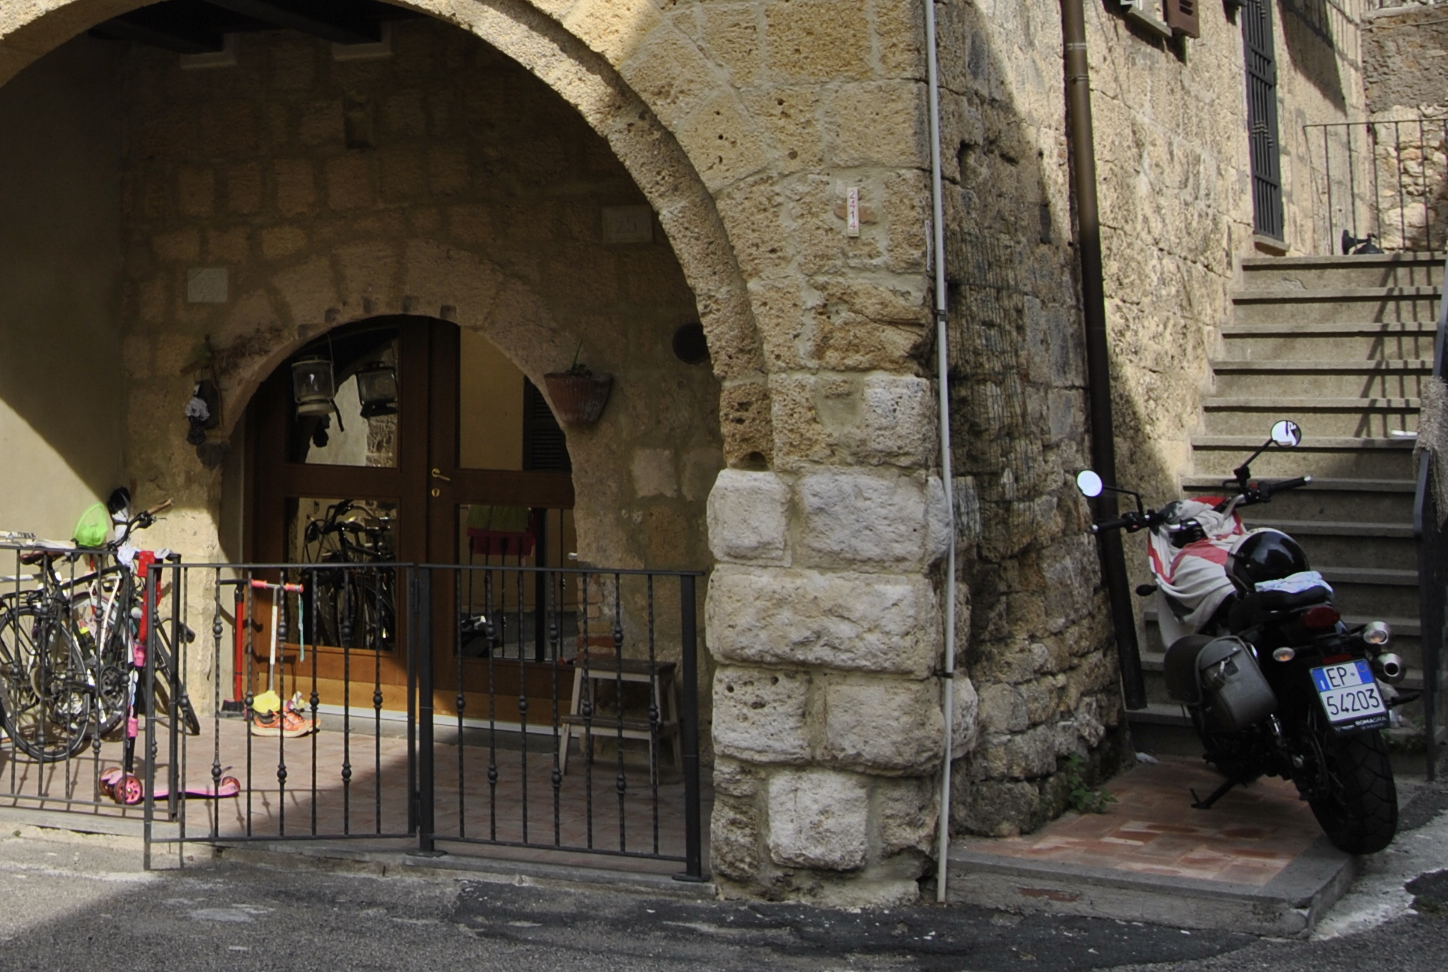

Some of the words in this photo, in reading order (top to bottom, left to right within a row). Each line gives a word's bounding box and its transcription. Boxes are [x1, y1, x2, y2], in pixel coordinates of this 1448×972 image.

[849, 189, 857, 230] 2414
[1326, 666, 1347, 688] EP
[1326, 688, 1381, 716] 54203
